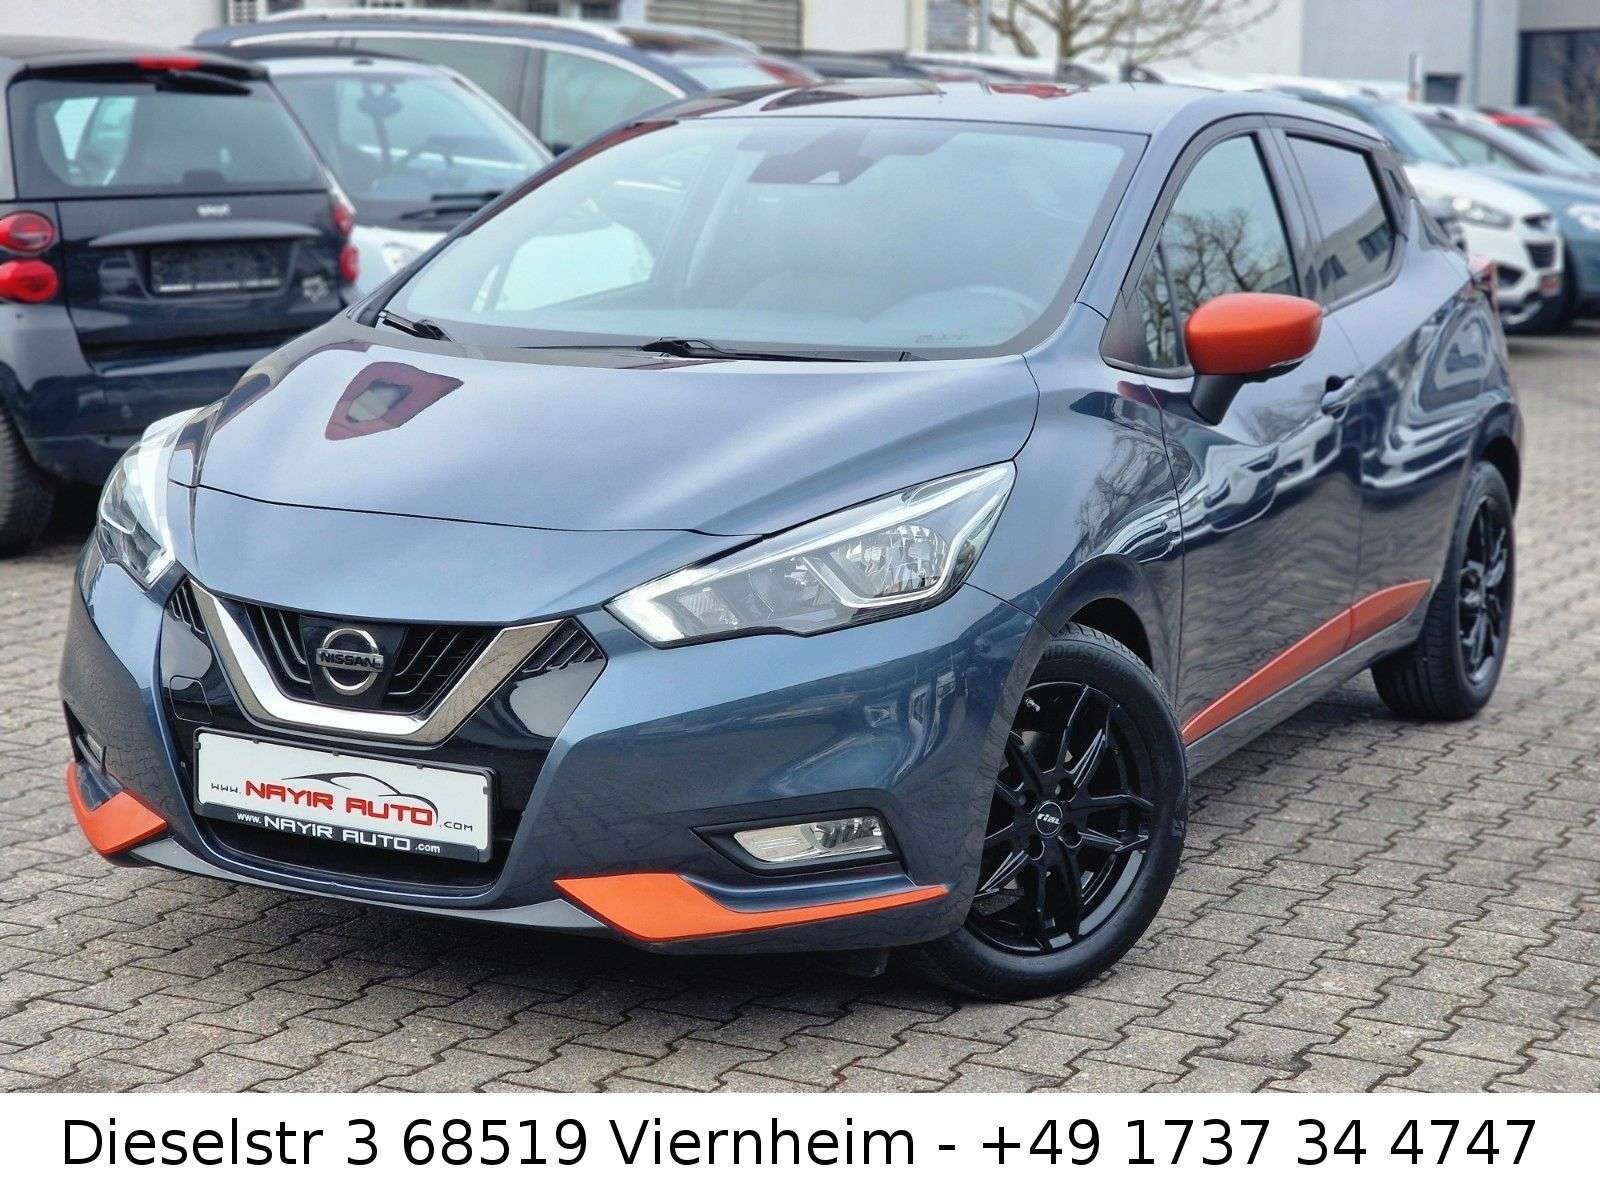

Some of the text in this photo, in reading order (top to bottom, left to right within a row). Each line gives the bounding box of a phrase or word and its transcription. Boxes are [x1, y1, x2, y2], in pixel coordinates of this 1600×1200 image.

[320, 651, 380, 669] NISSAN
[245, 780, 333, 810] NAYIR
[346, 797, 432, 826] AUTO
[264, 815, 333, 839] NAYIR
[342, 829, 411, 851] AUTO
